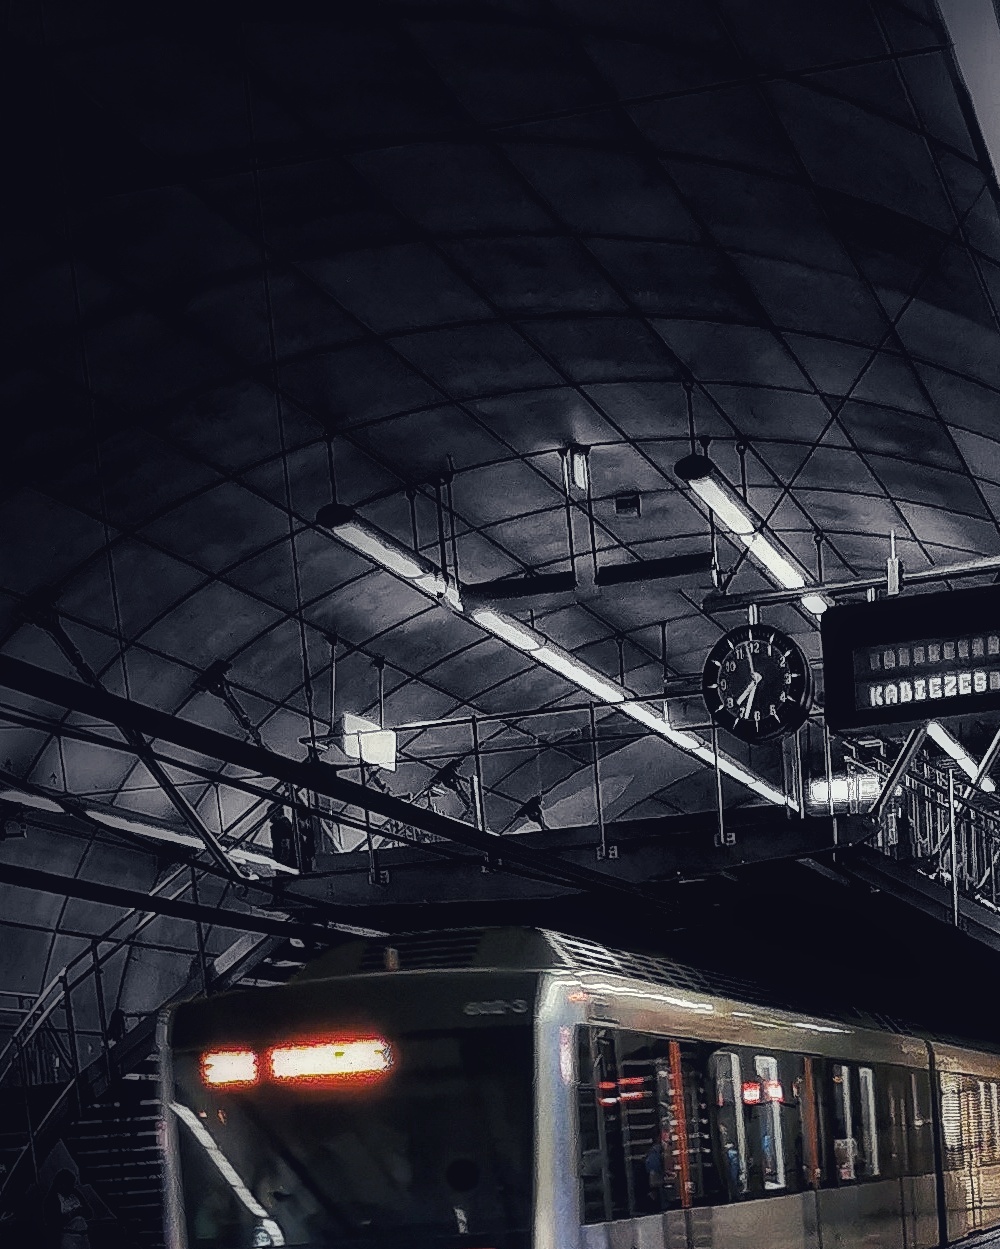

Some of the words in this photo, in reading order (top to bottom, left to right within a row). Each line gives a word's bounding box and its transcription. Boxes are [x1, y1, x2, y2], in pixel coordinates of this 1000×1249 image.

[749, 642, 760, 654] 12
[767, 644, 772, 657] 1
[725, 661, 737, 673] 10
[780, 656, 786, 668] 2
[720, 679, 727, 691] 9
[784, 673, 792, 685] 3
[726, 697, 734, 709] 8
[780, 691, 787, 703] 4
[739, 707, 746, 719] 7
[769, 704, 776, 716] 5
